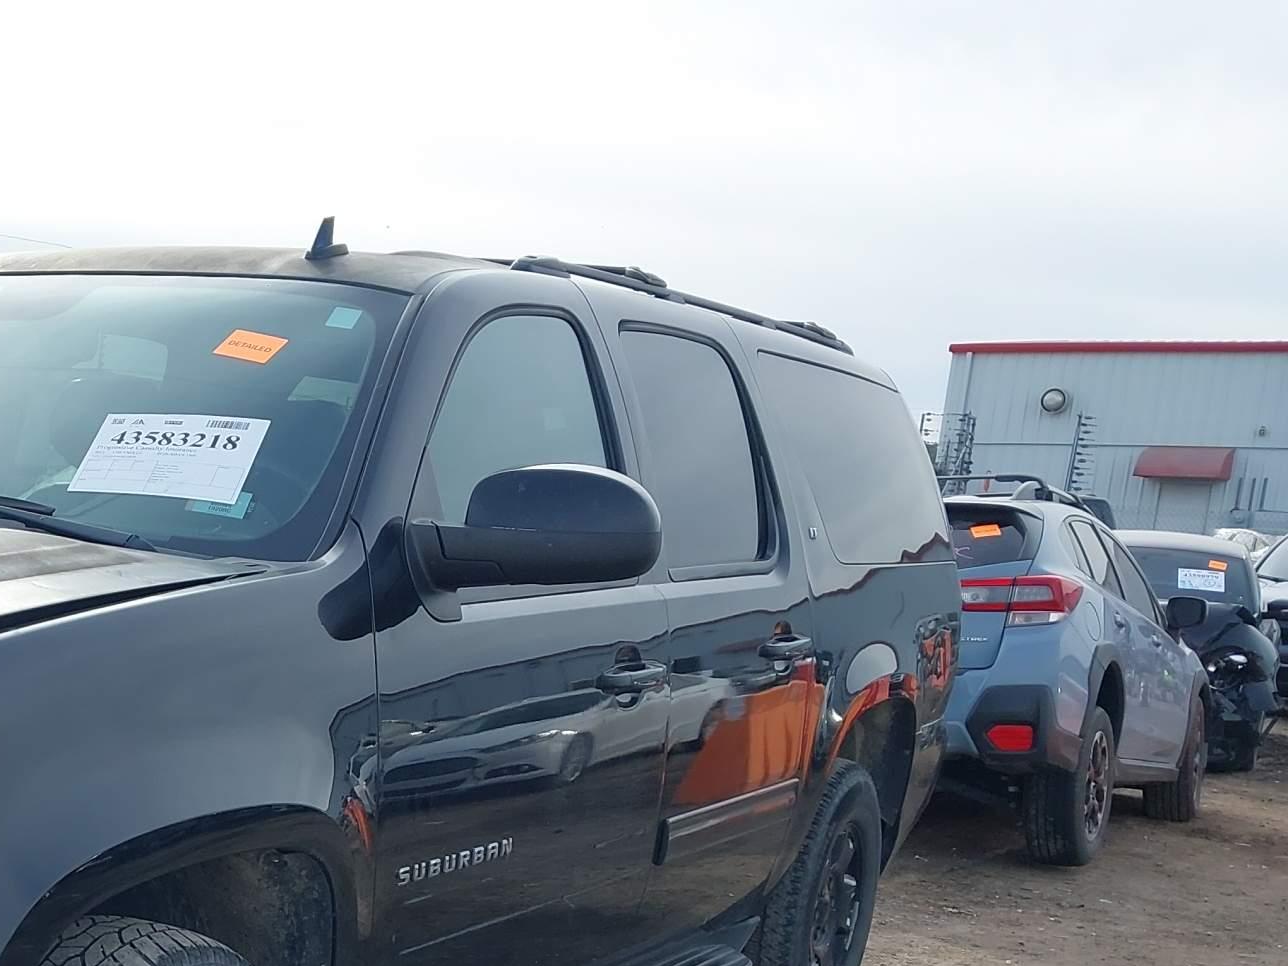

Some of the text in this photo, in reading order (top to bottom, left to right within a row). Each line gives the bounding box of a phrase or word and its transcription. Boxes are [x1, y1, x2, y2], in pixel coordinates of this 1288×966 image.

[228, 339, 272, 353] DETAILED
[111, 430, 241, 451] 43583218
[397, 837, 513, 886] SUBURBAN
